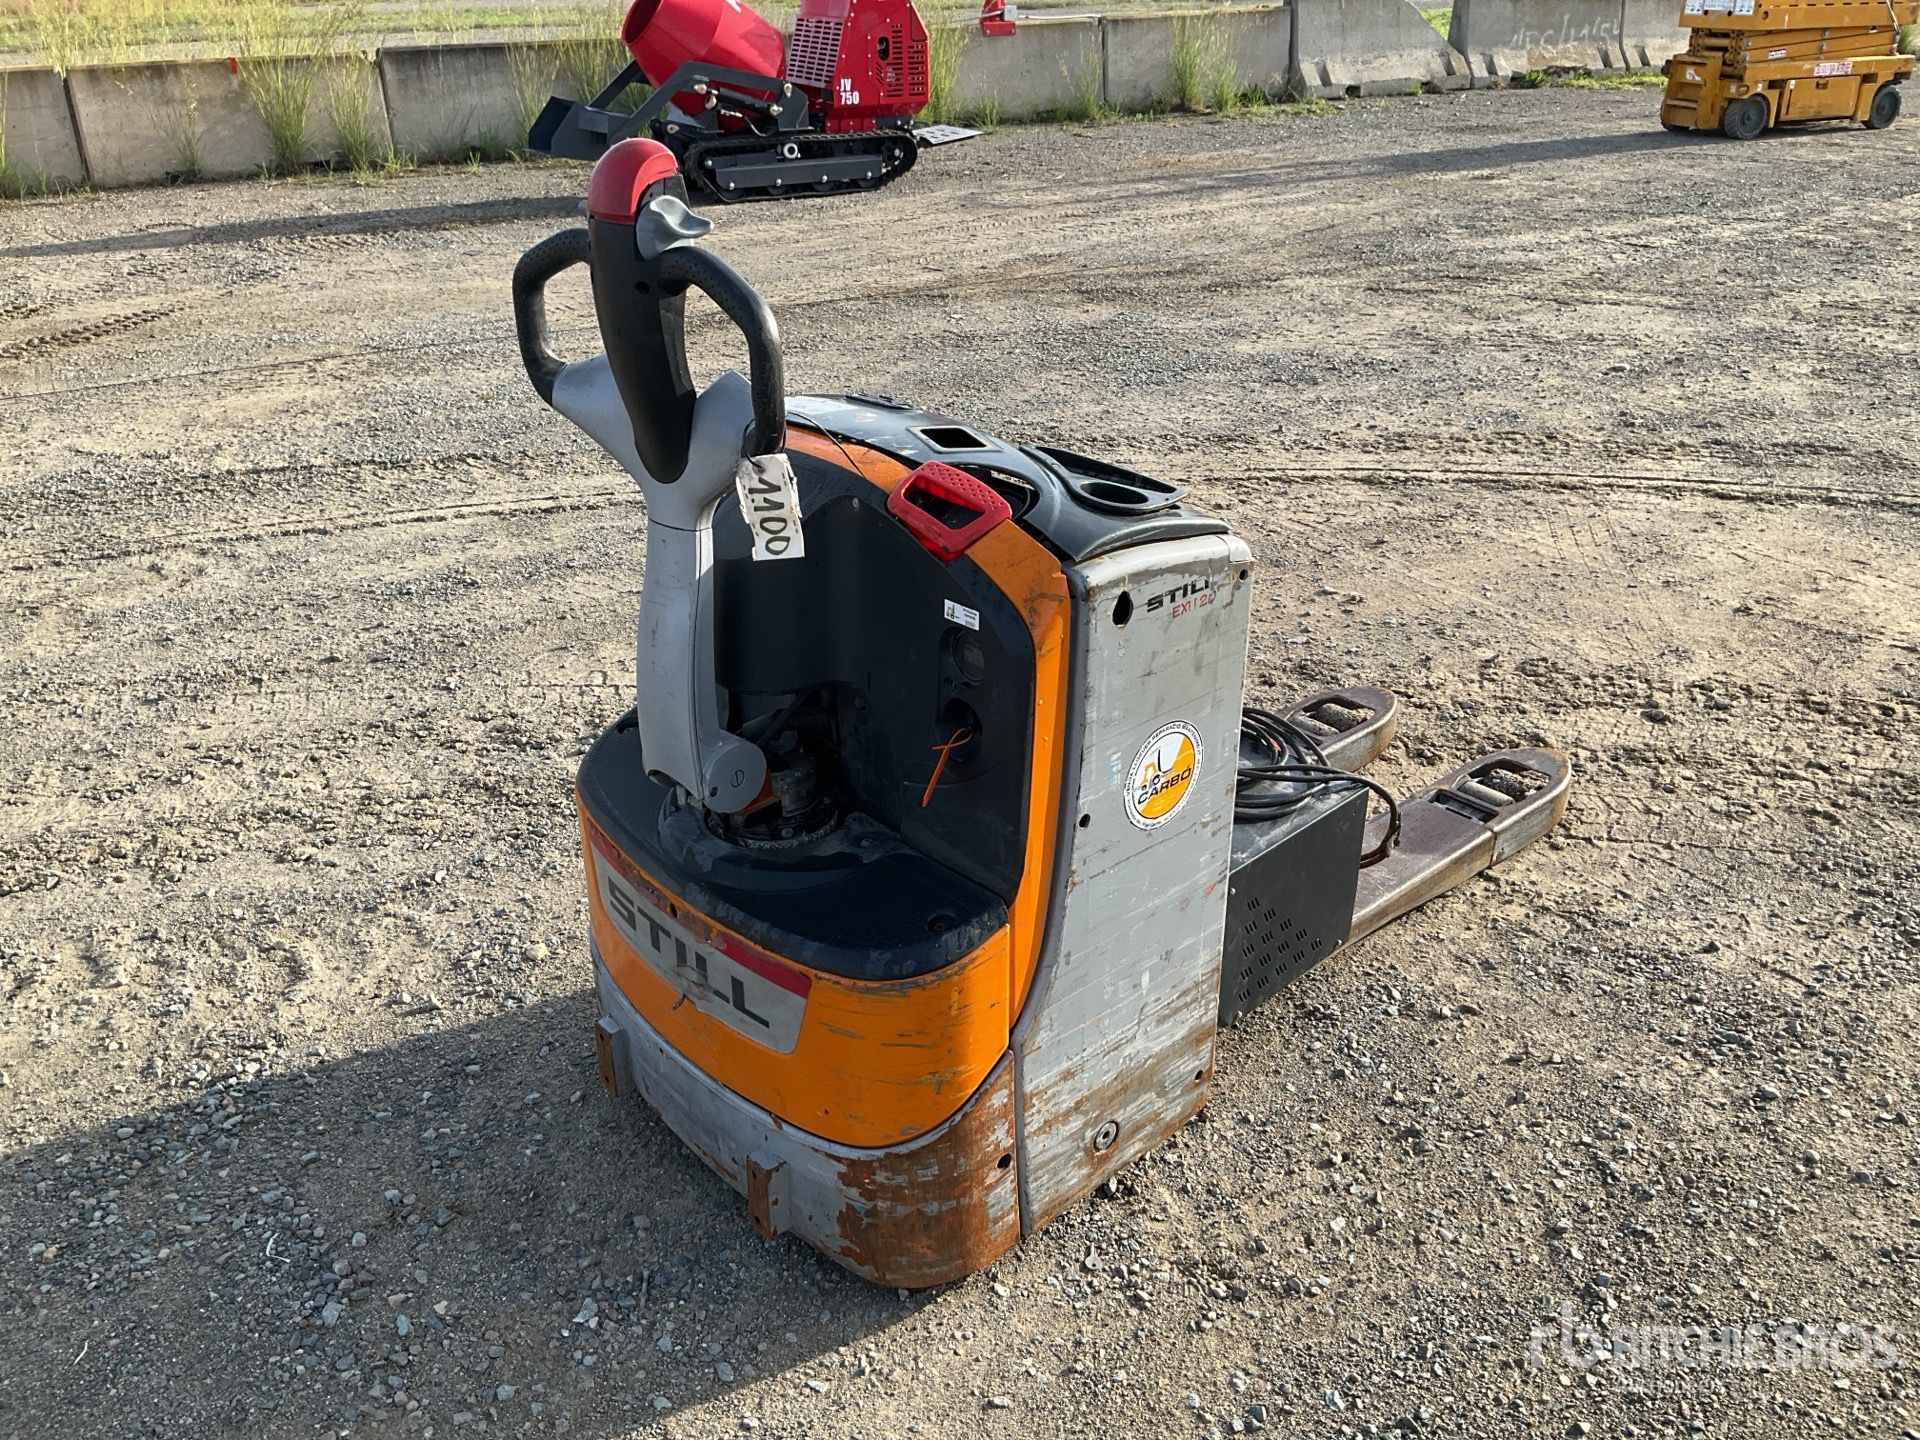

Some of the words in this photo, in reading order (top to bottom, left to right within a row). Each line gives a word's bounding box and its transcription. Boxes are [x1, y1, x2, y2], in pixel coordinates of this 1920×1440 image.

[840, 78, 851, 91] JV
[840, 91, 860, 105] 750
[1138, 765, 1192, 805] CARBÓ
[608, 877, 770, 1029] STILL
